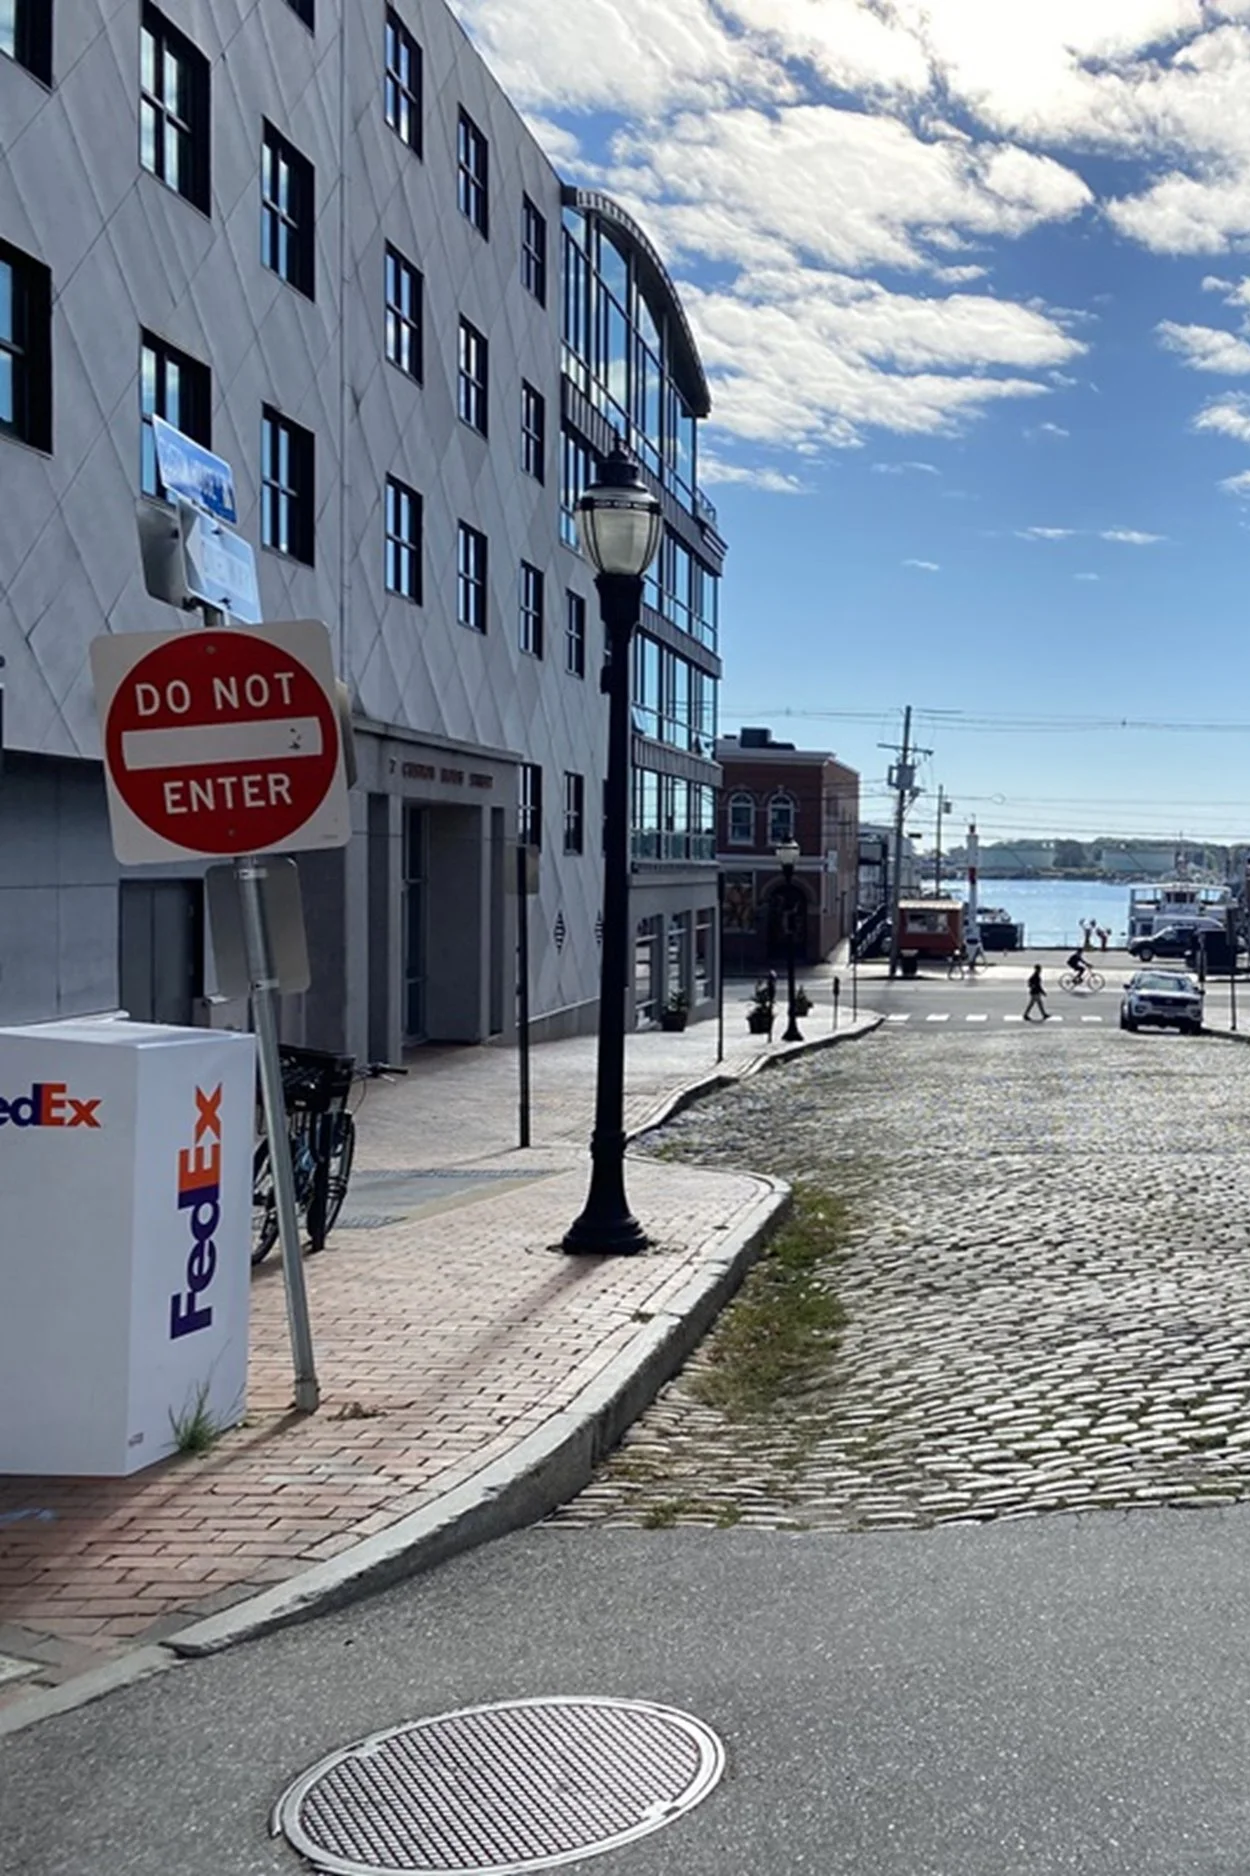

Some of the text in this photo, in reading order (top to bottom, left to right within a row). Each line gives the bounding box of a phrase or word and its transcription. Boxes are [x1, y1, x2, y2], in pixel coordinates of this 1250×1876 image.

[135, 672, 294, 716] DO NOT
[164, 773, 292, 814] ENTER
[170, 1082, 222, 1340] FedEx
